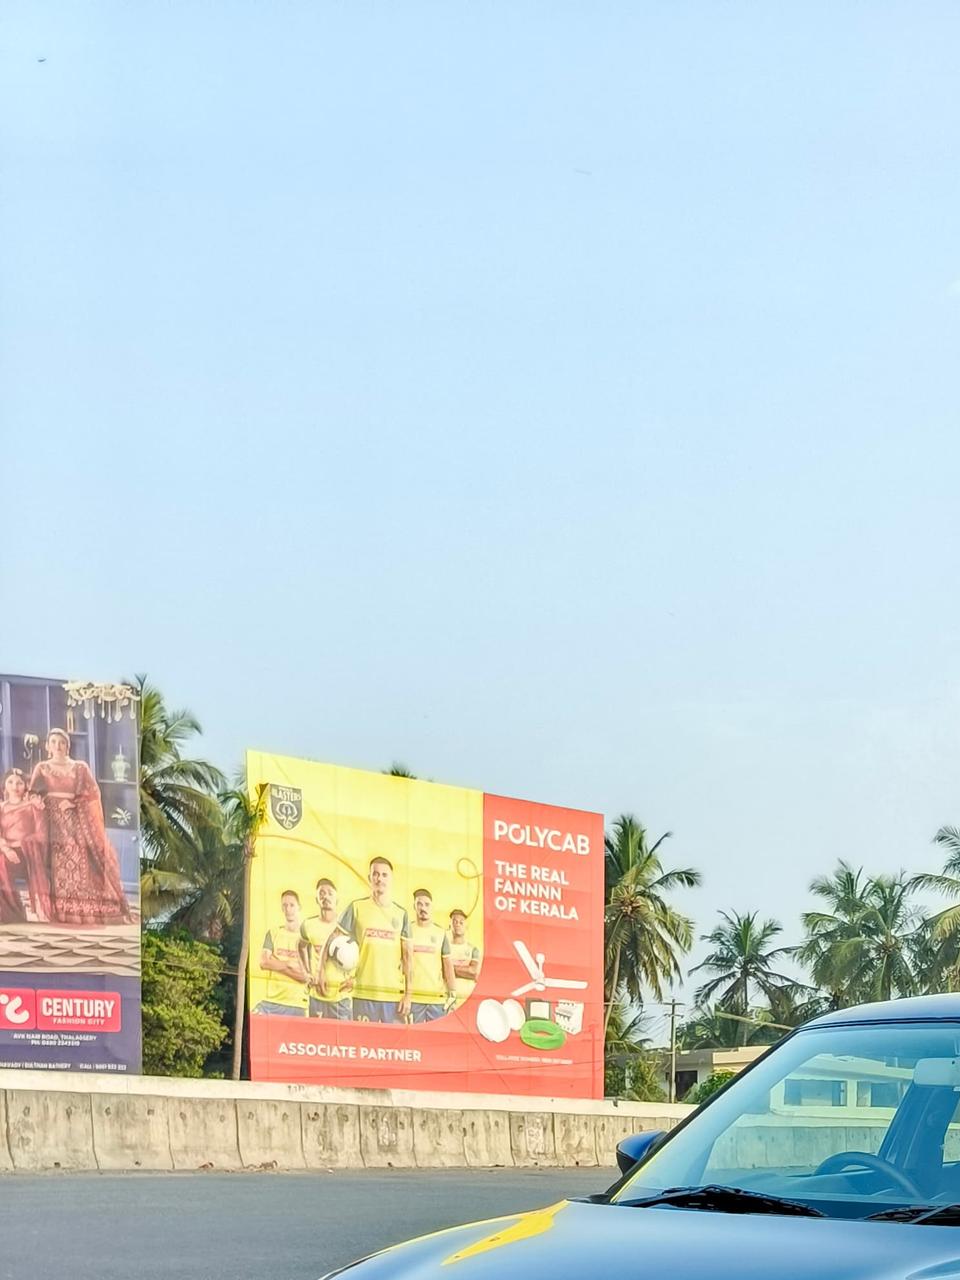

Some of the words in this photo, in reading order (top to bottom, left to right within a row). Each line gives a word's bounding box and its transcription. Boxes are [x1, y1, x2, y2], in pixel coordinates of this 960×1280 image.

[493, 820, 590, 856] POLYCAB
[494, 860, 526, 879] THE
[530, 865, 569, 886] REAL
[494, 881, 562, 901] FANNNN
[494, 895, 517, 913] OF
[520, 899, 579, 921] KERALA
[42, 997, 115, 1018] CENTURY
[87, 1018, 105, 1026] CITY
[278, 1042, 356, 1060] ASSOCIATE
[360, 1047, 422, 1063] PARTNER
